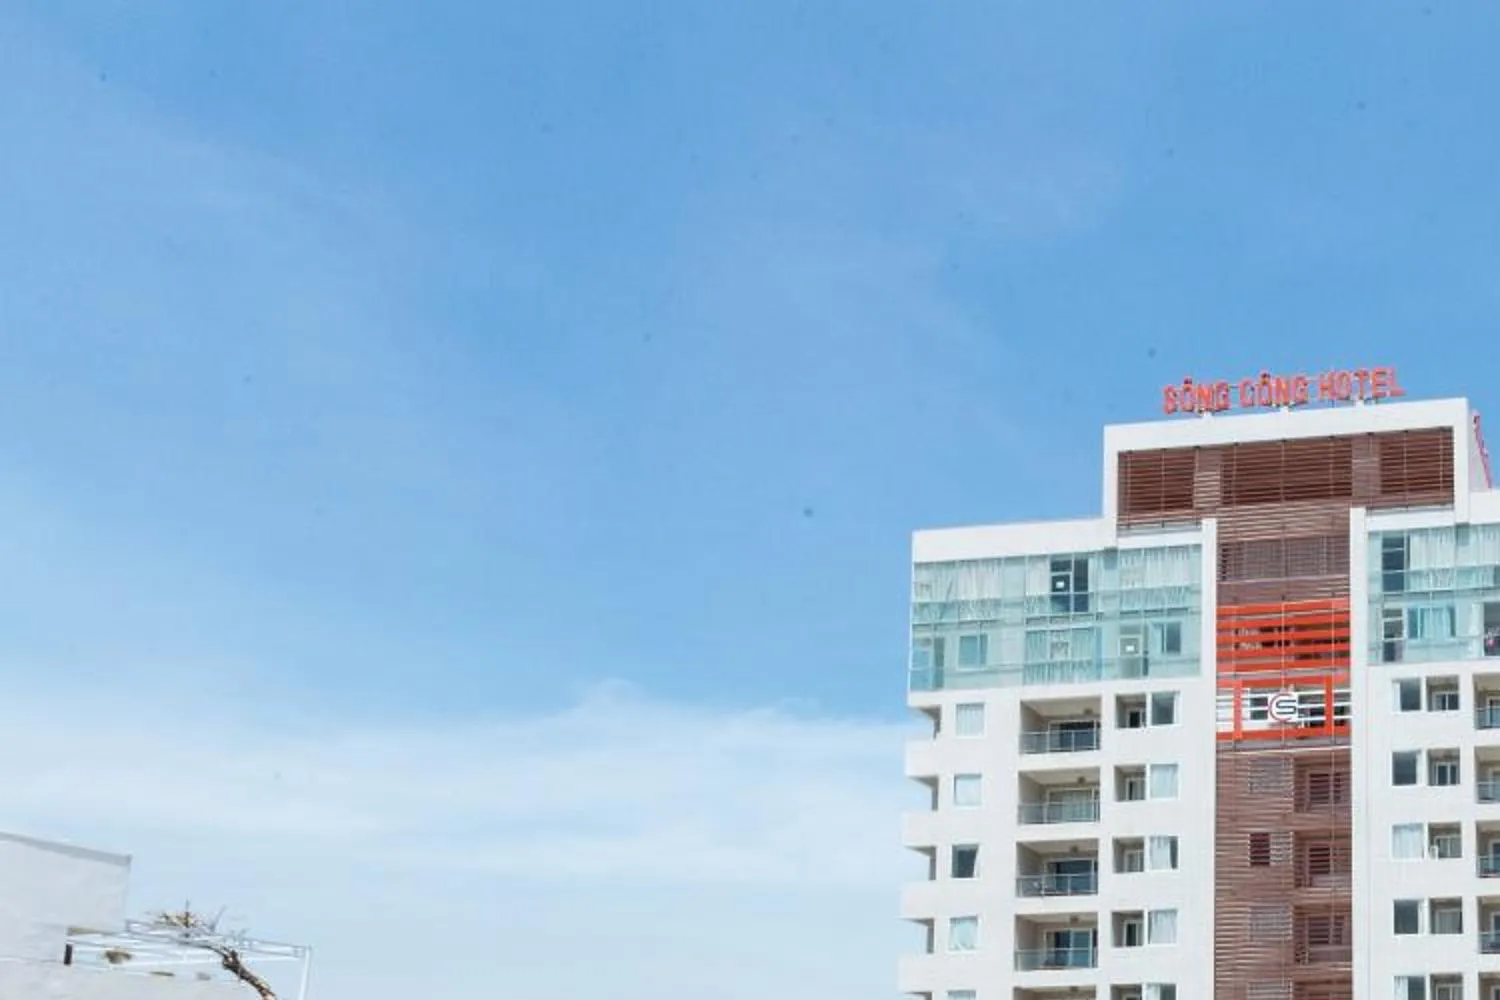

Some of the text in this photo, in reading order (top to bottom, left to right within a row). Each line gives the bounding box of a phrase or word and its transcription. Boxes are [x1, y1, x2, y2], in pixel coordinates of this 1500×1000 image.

[1164, 366, 1406, 414] SÔNG CÔNG HOTEL
